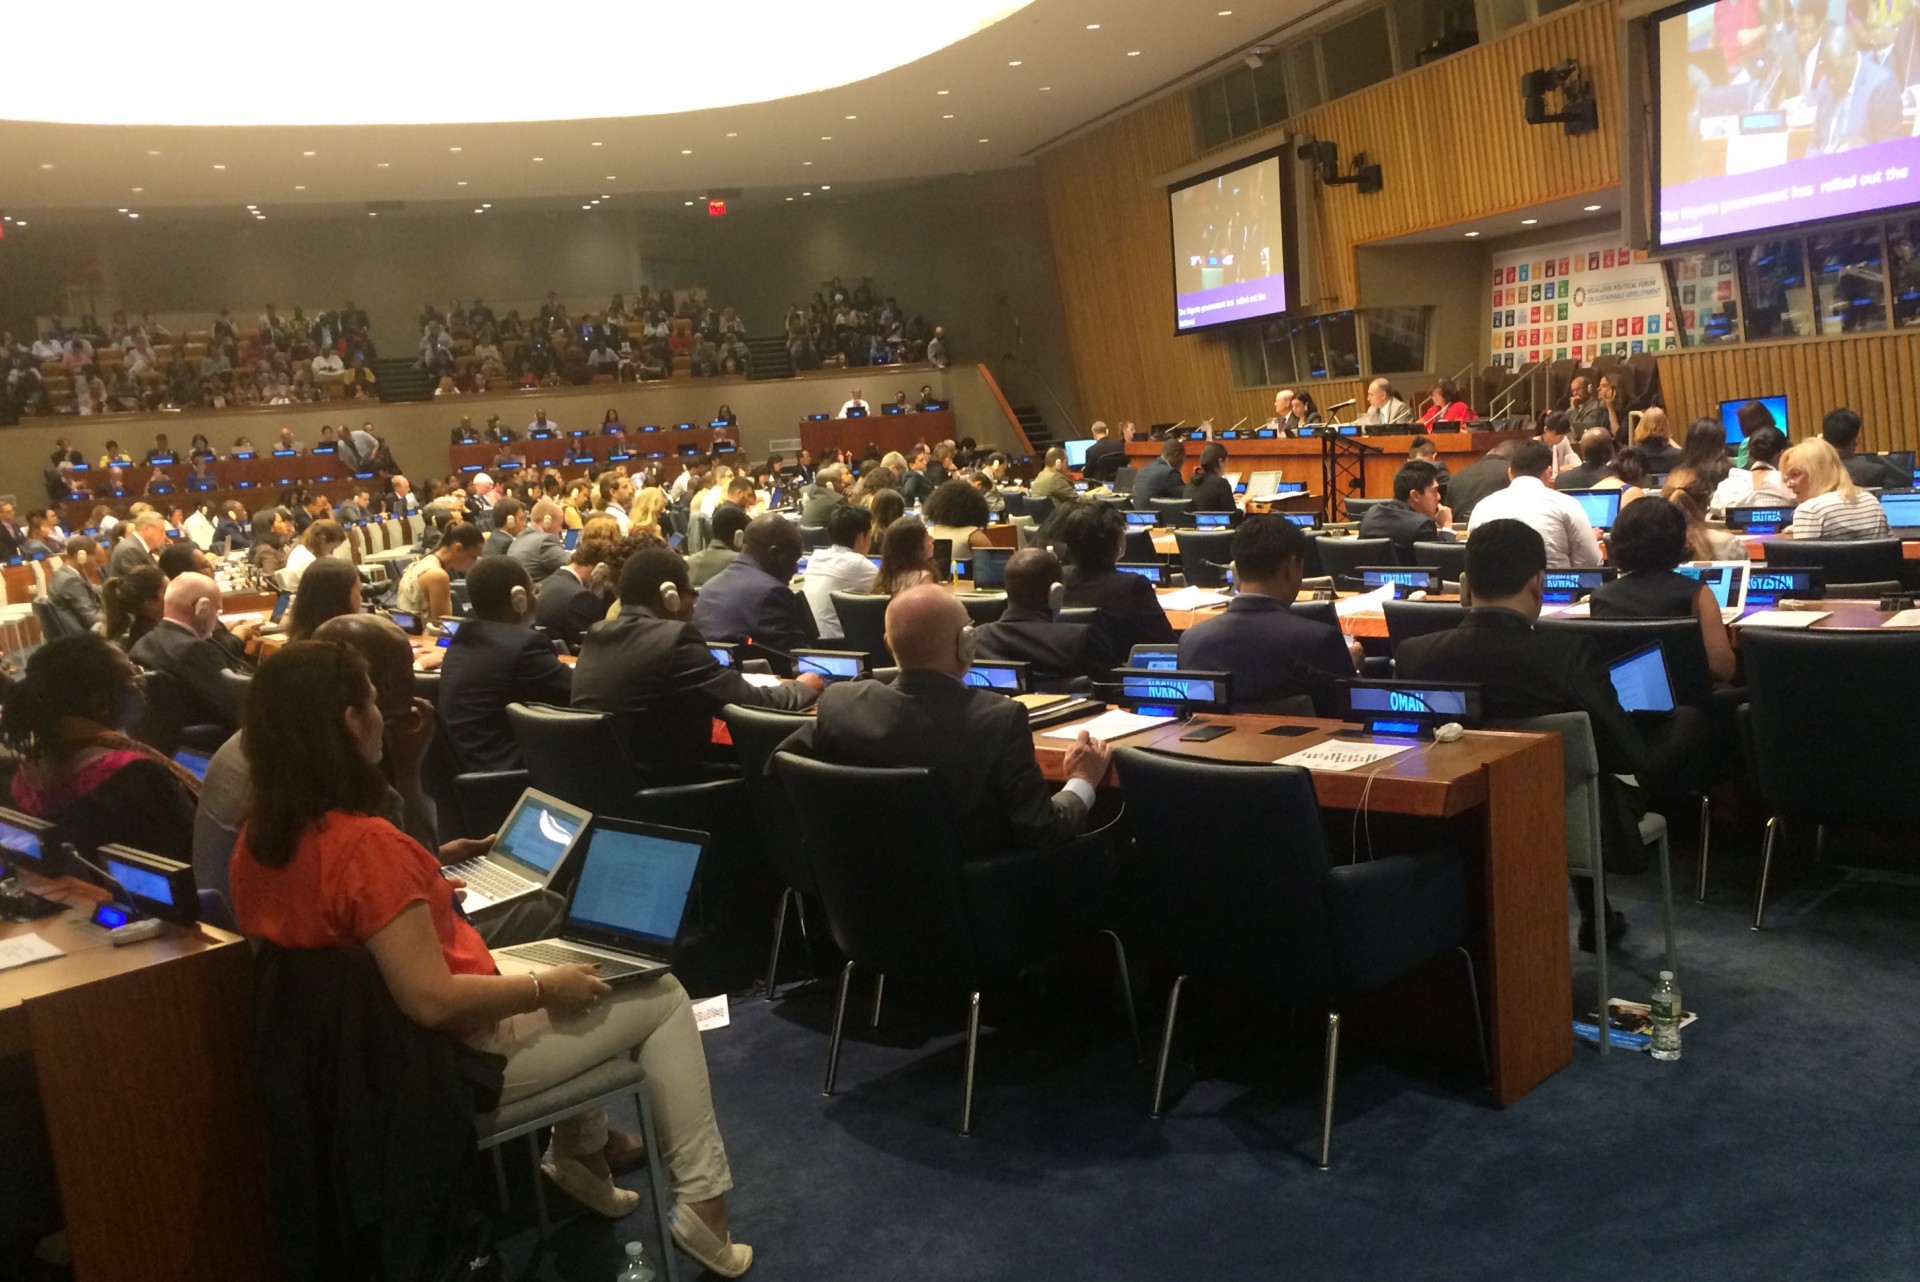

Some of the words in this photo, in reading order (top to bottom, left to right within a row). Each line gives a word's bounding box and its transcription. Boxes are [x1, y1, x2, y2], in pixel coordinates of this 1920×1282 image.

[1859, 169, 1883, 188] out
[1885, 166, 1909, 182] the
[1613, 282, 1638, 291] POLITICAL
[1637, 279, 1657, 288] FORUM
[1751, 510, 1782, 522] ERITREA
[1546, 574, 1580, 588] KUWAIT
[1747, 574, 1794, 589] GYZSTAN
[1147, 680, 1189, 699] NORWAY
[1389, 691, 1425, 712] OMAN
